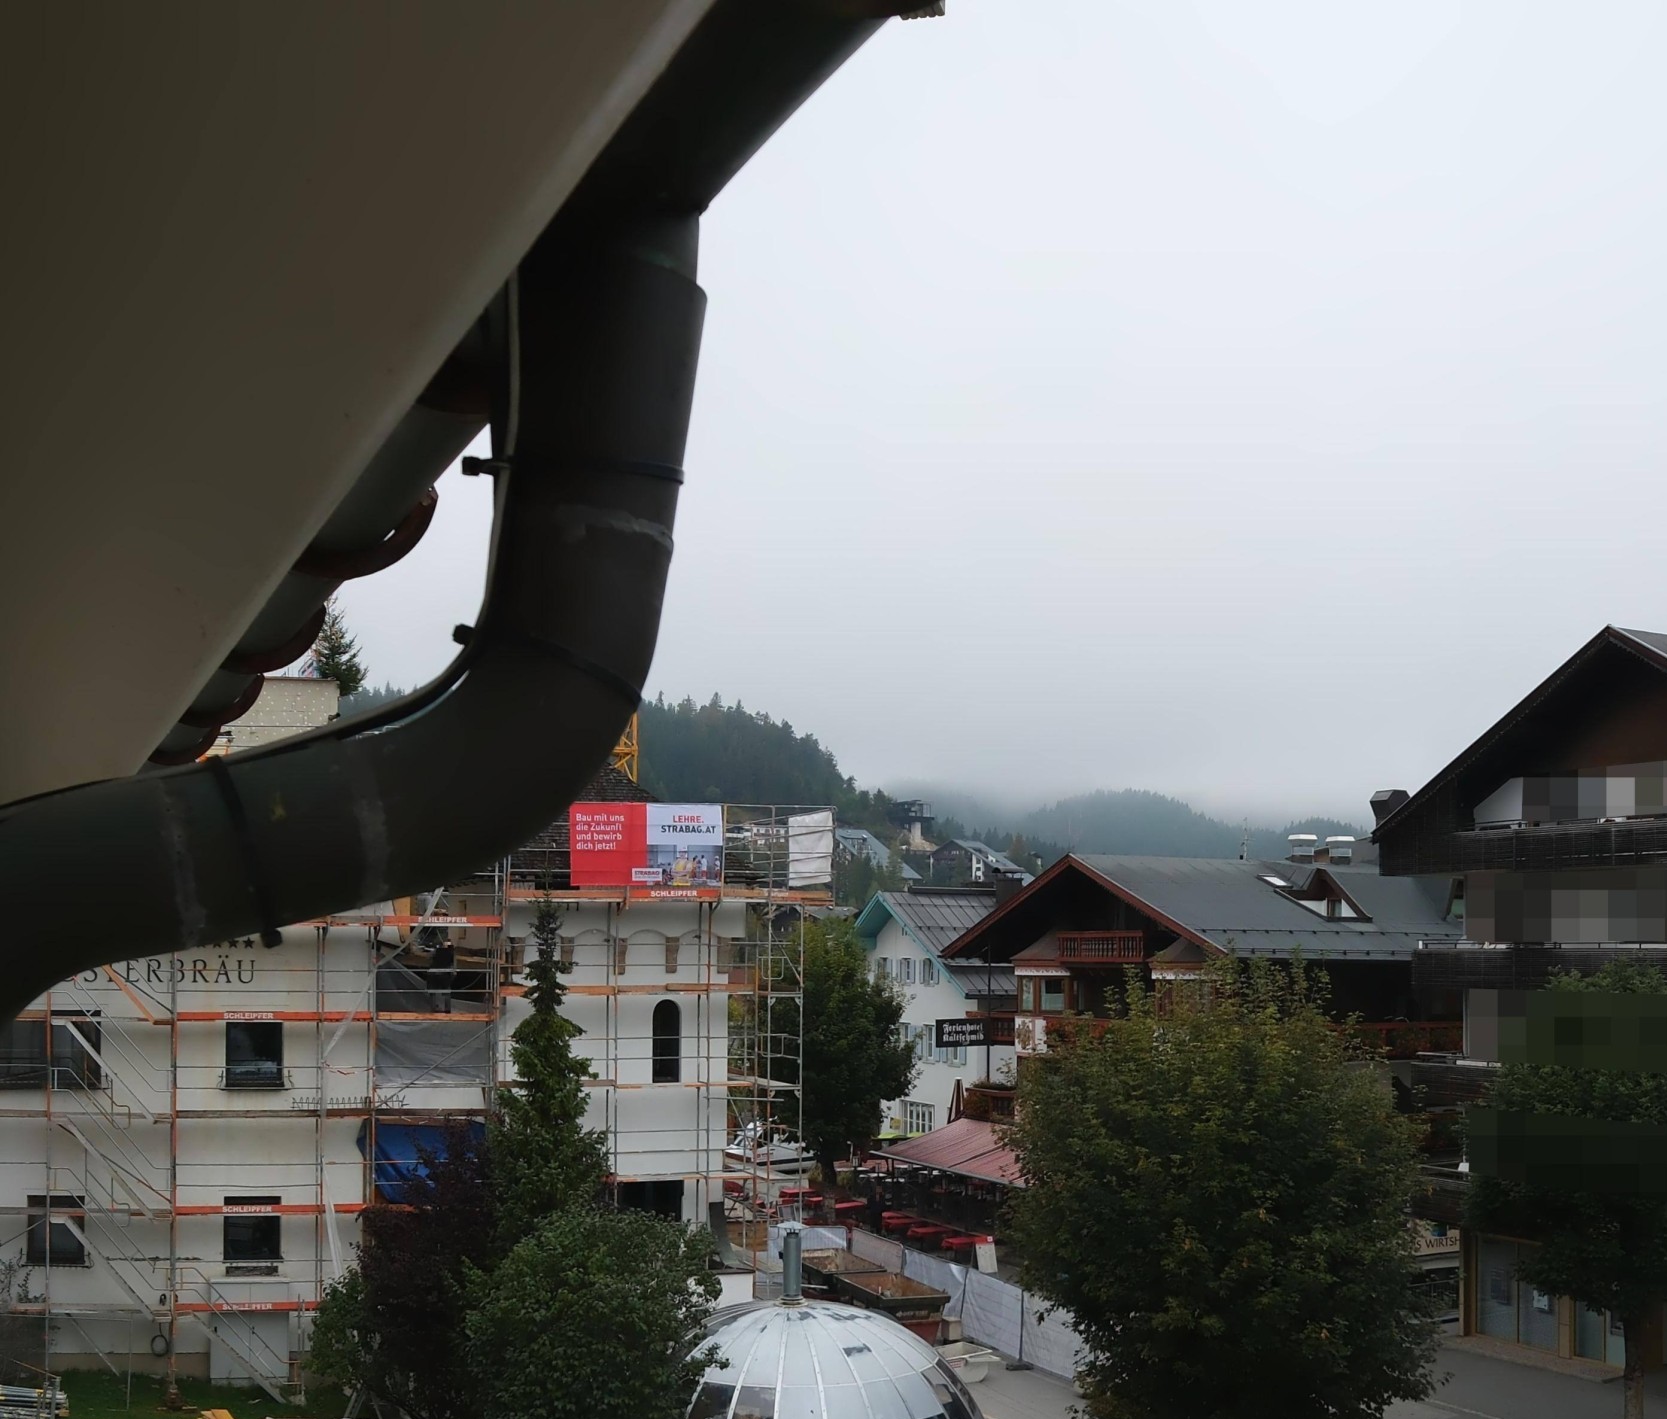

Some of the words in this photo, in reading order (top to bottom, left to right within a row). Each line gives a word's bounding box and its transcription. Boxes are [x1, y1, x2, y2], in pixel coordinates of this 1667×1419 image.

[575, 813, 592, 822] Bau
[593, 813, 607, 822] mit
[672, 815, 705, 823] LEHRE.
[575, 823, 588, 831] die
[590, 823, 622, 831] Zukunft
[660, 825, 717, 834] STRABAG.AT
[576, 832, 592, 840] und
[593, 832, 623, 841] bewirb
[576, 842, 593, 850] dich
[594, 843, 616, 851] jetzt!
[650, 889, 698, 897] SCHLEIPFER
[223, 1012, 274, 1020] SCHLEIPFER
